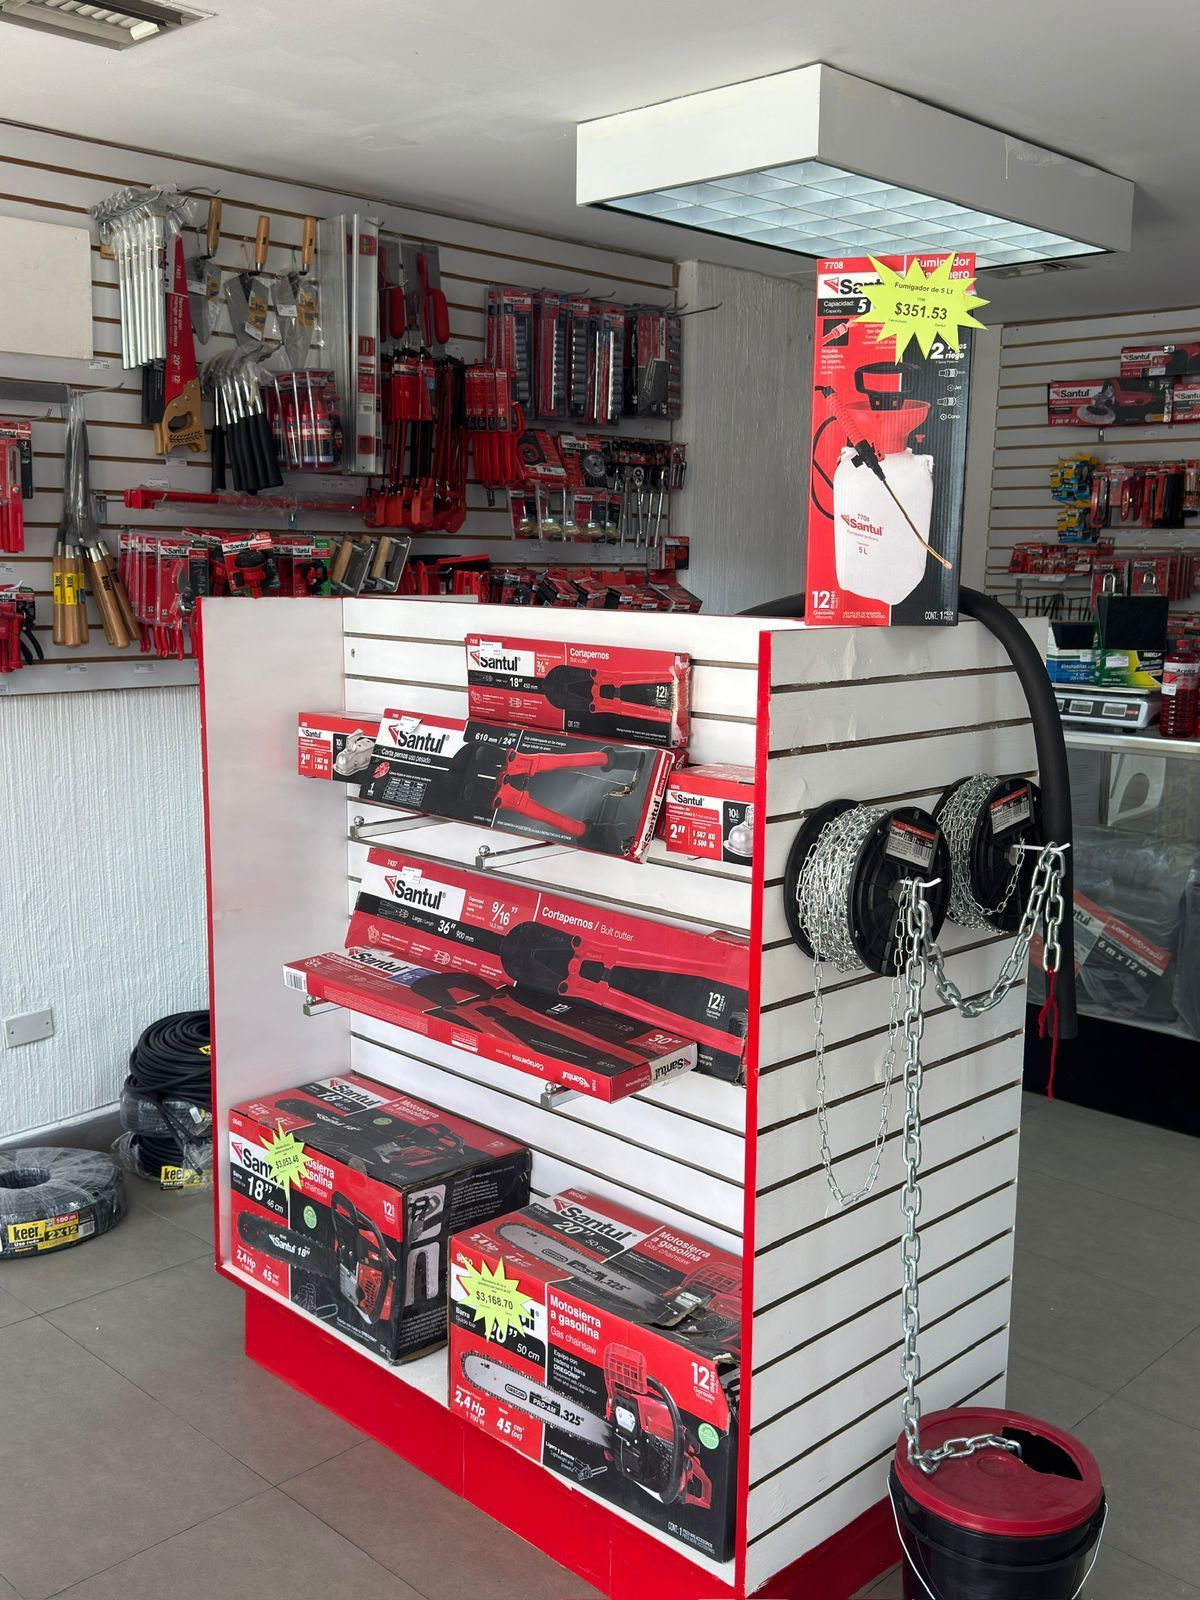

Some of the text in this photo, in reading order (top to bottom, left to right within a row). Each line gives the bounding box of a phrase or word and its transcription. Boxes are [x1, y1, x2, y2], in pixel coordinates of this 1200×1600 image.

[894, 282, 930, 292] Fumigador
[857, 299, 868, 313] 5
[894, 302, 947, 320] $351.53
[930, 342, 944, 359] 2
[857, 514, 870, 522] 7708
[850, 519, 882, 536] Santul
[102, 576, 112, 591] keer
[812, 591, 830, 608] 12
[570, 648, 609, 660] Cortapernos
[480, 656, 517, 671] Santul
[510, 678, 523, 687] 18"
[398, 731, 446, 753] Santul
[475, 733, 488, 741] 610
[382, 748, 393, 757] Corta
[394, 751, 408, 759] pernos
[678, 794, 702, 806] Santul
[645, 800, 660, 842] Santul
[670, 824, 685, 838] 2"
[395, 879, 442, 910] Santul
[438, 920, 456, 934] 36"
[456, 931, 465, 939] 900
[542, 907, 634, 942] Cortapernos / Bolt cutter
[1112, 922, 1164, 960] Lona reforzada
[350, 951, 408, 973] Santul
[1105, 947, 1116, 956] m
[1125, 959, 1138, 970] 12
[1137, 969, 1148, 978] m
[707, 992, 720, 1010] 12
[648, 1034, 681, 1045] 30"
[512, 1054, 544, 1071] Cortapernos
[654, 1058, 684, 1081] Santul
[561, 1071, 585, 1085] Santul
[317, 1092, 352, 1103] 18"
[333, 1081, 379, 1106] Santul
[401, 1100, 439, 1118] Motosierra
[275, 1155, 299, 1169] $3,053.48
[248, 1176, 284, 1213] 18" 46 cm
[383, 1201, 391, 1215] 12
[48, 1225, 77, 1239] 2X12
[560, 1207, 633, 1241] Santul
[14, 1226, 39, 1241] keer
[552, 1222, 611, 1254] 20" 50 cm
[274, 1237, 295, 1253] Santul
[644, 1241, 657, 1252] Gas
[658, 1248, 690, 1266] chainsaw
[658, 1232, 710, 1259] Motosierra
[660, 1239, 702, 1263] gasolina
[247, 1256, 256, 1269] Hp
[263, 1269, 272, 1281] 45
[476, 1291, 513, 1310] $3,168.70
[456, 1306, 470, 1318] Barra
[551, 1295, 601, 1328] Motosierra
[456, 1316, 468, 1326] Guide
[550, 1310, 599, 1340] a gasolina
[550, 1327, 596, 1355] Gas chainsaw
[517, 1343, 540, 1361] 50 cm
[554, 1349, 569, 1361] Equipo
[553, 1358, 570, 1368] cadena
[691, 1361, 710, 1390] 12
[455, 1390, 485, 1417] 2,4 Hp
[533, 1399, 556, 1414] PRO-AM
[497, 1418, 512, 1434] 45
[680, 1527, 682, 1536] 1
